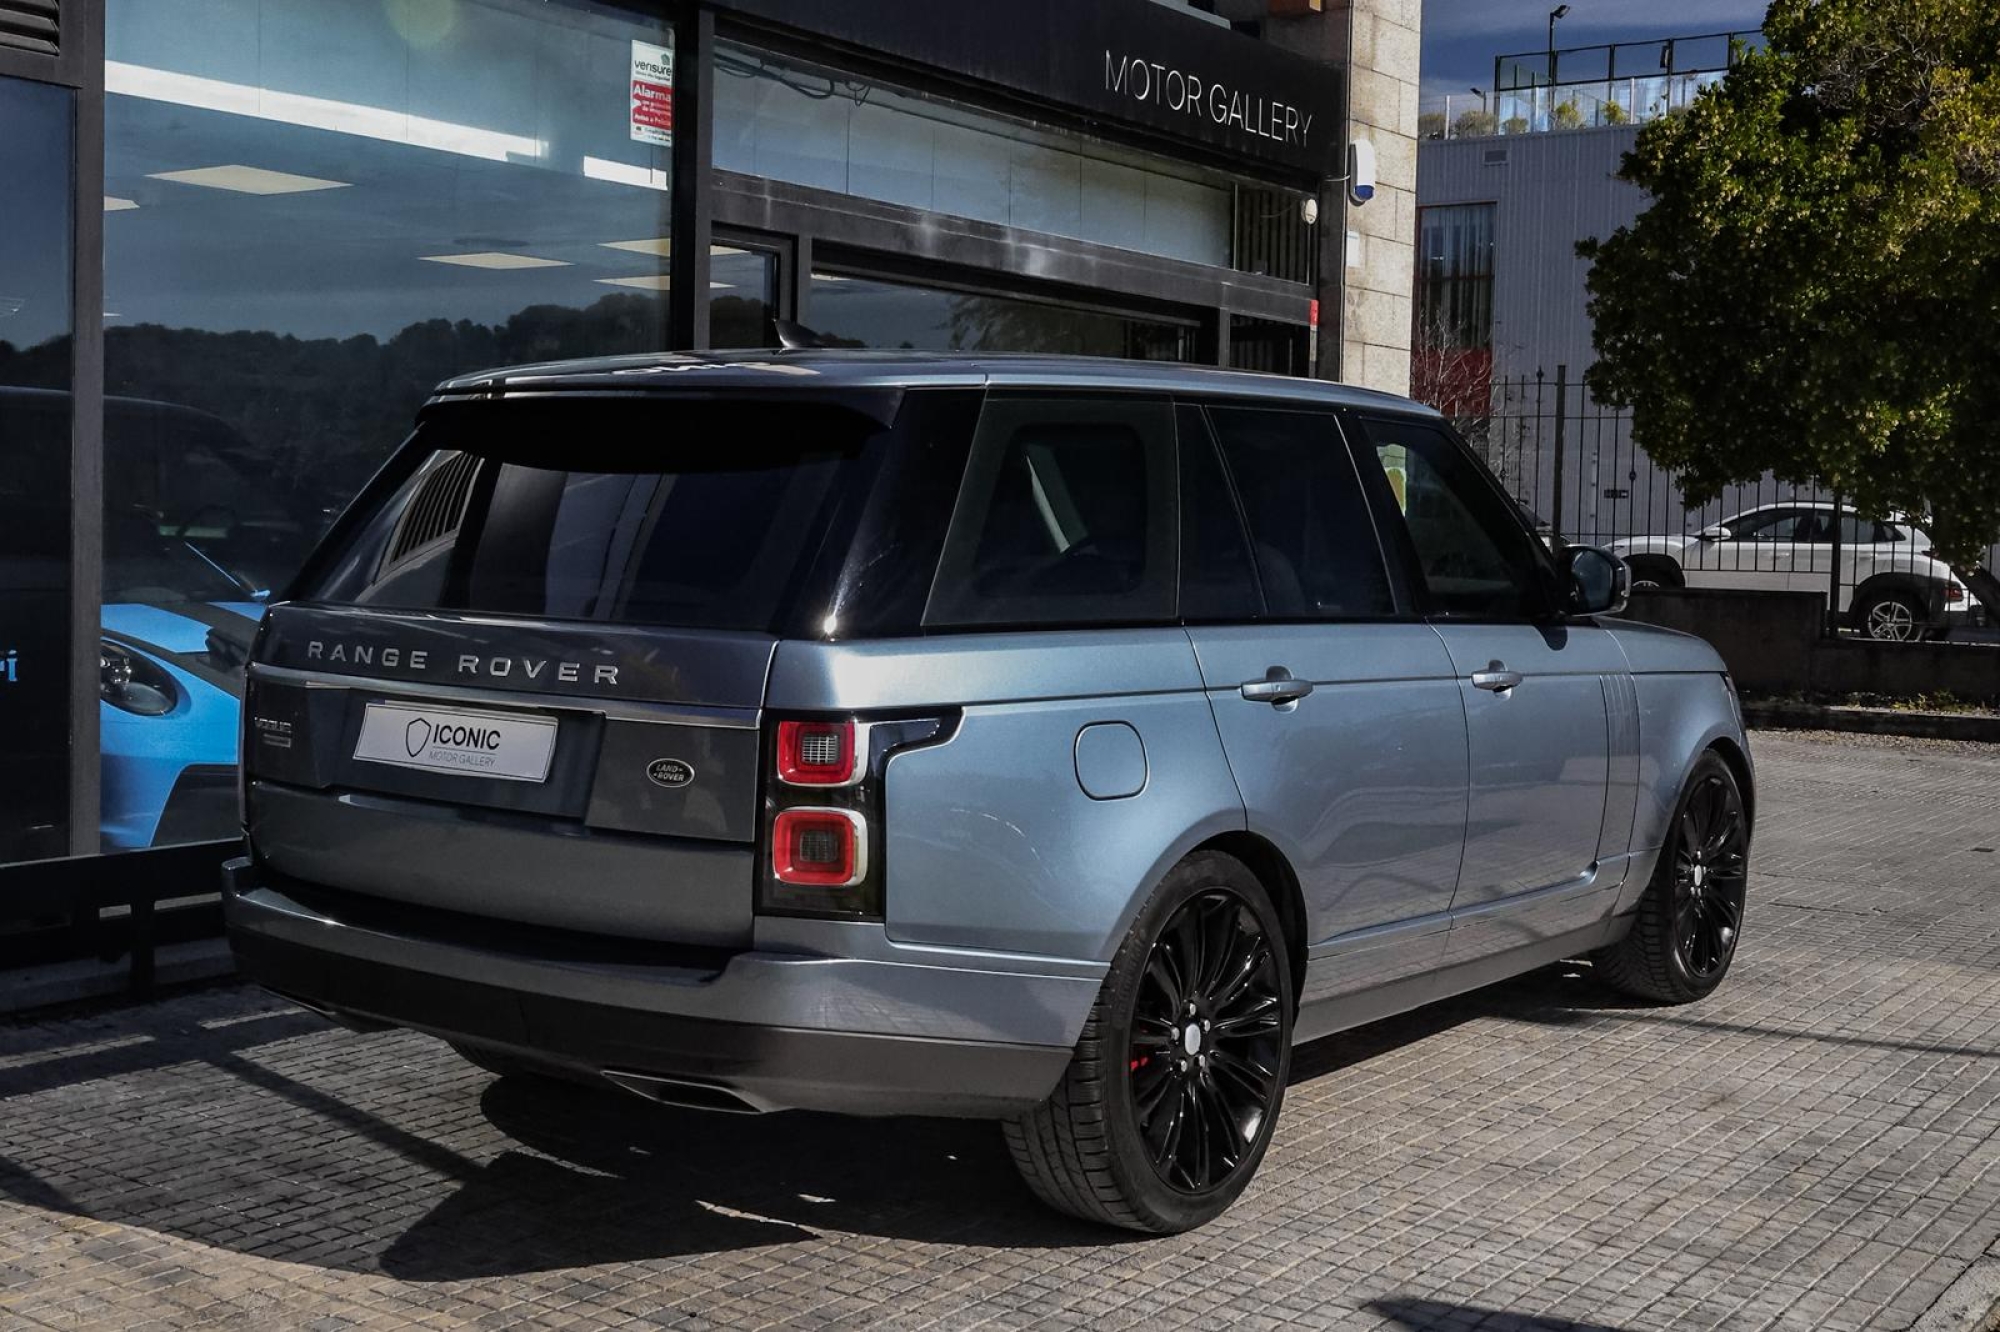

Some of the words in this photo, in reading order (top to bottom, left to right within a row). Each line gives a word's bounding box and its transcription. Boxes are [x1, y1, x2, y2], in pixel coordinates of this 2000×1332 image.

[633, 83, 671, 101] Alarma
[1105, 49, 1202, 117] MOTOR
[1209, 83, 1312, 148] GALLERY
[307, 640, 429, 670] RANGE
[457, 654, 619, 685] ROVER
[433, 723, 501, 751] ICONIC
[429, 750, 458, 763] MOTOR
[459, 754, 496, 767] GALLERY
